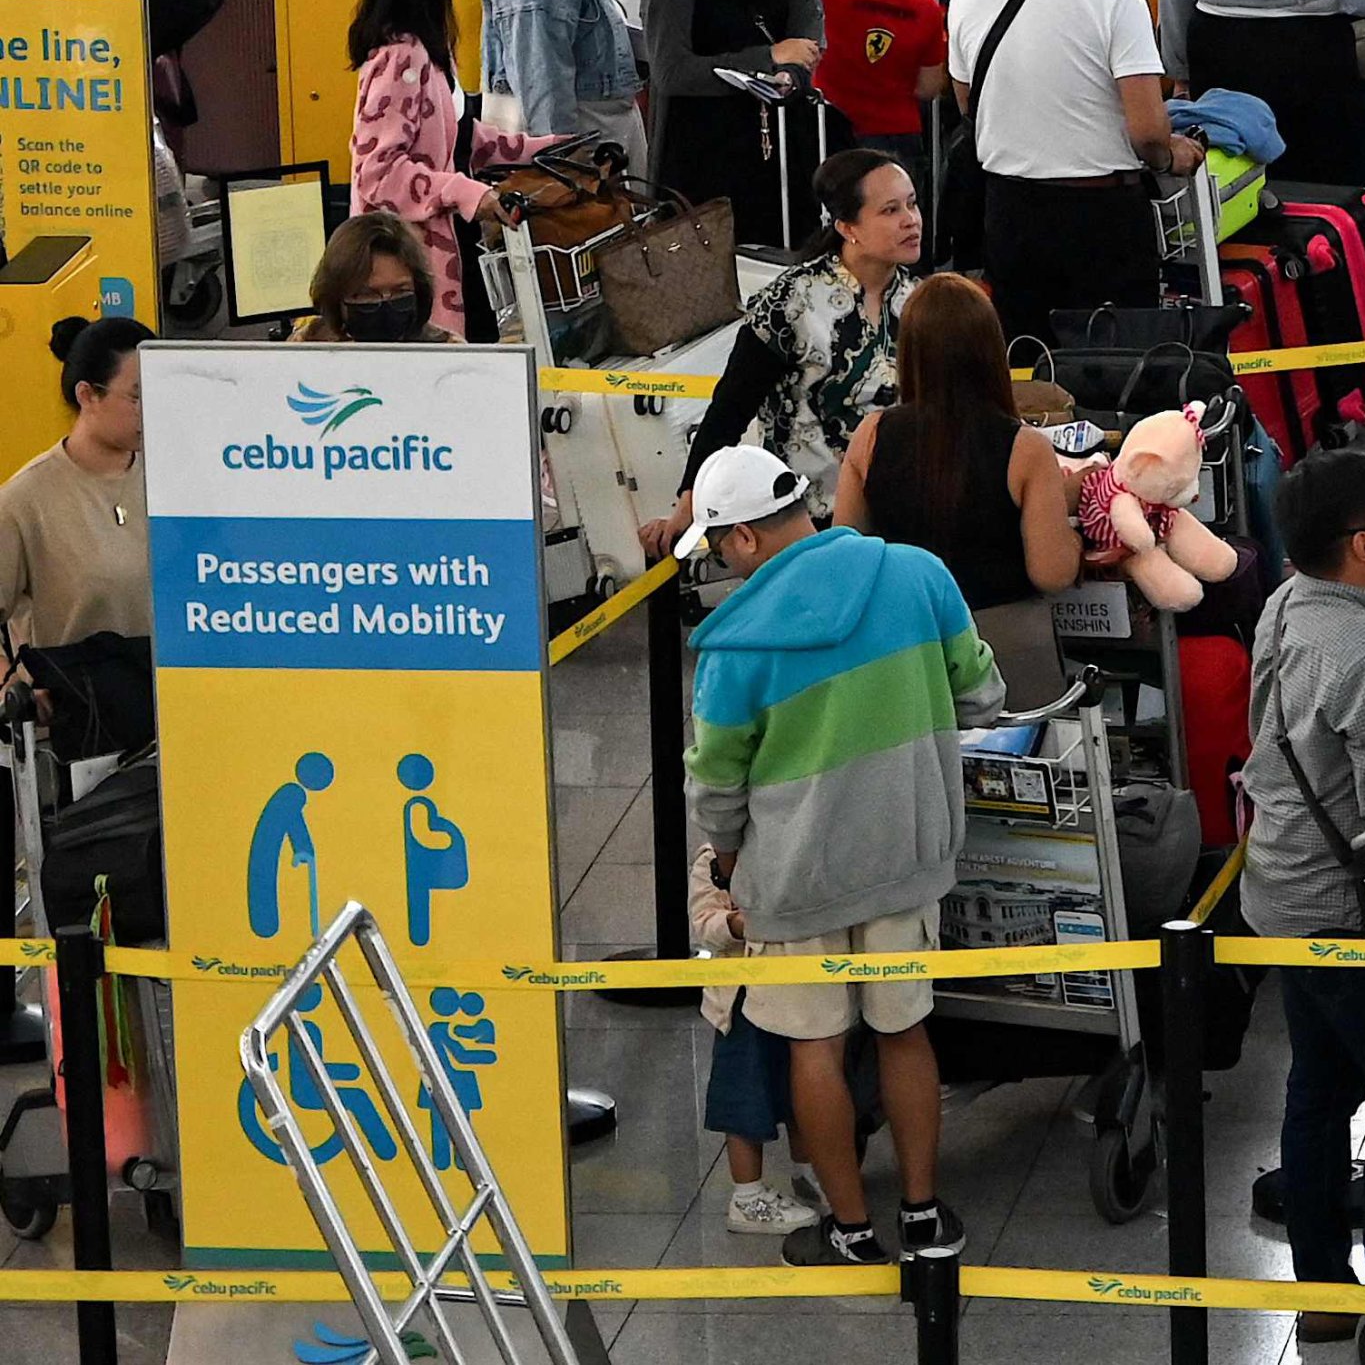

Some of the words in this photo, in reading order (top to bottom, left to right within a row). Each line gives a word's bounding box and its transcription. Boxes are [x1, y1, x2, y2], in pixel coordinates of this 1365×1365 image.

[42, 28, 121, 68] line,
[17, 137, 54, 153] Scan
[59, 138, 85, 153] the
[18, 160, 41, 175] QR
[45, 160, 81, 175] code
[85, 161, 102, 175] to
[20, 181, 62, 196] settle
[66, 184, 102, 199] your
[21, 202, 81, 218] balance
[85, 204, 134, 218] online
[1237, 359, 1273, 373] pacific
[625, 380, 650, 392] cebu
[651, 381, 685, 394] pacific
[221, 434, 313, 472] cebu
[323, 436, 454, 480] pacific
[195, 553, 398, 595] Passengers
[408, 555, 490, 588] with
[186, 601, 342, 635] Reduced
[352, 602, 506, 645] Mobility
[218, 962, 250, 977] cebu
[848, 961, 881, 977] cebu
[882, 959, 928, 979] pacific
[528, 971, 561, 986] cebu
[562, 970, 607, 987] pacific
[193, 1281, 227, 1295] cebu
[229, 1281, 277, 1298] pacific
[546, 1280, 573, 1294] ebu
[574, 1280, 623, 1297] pacific
[1117, 1286, 1151, 1300] cebu
[1154, 1287, 1203, 1303] pacific
